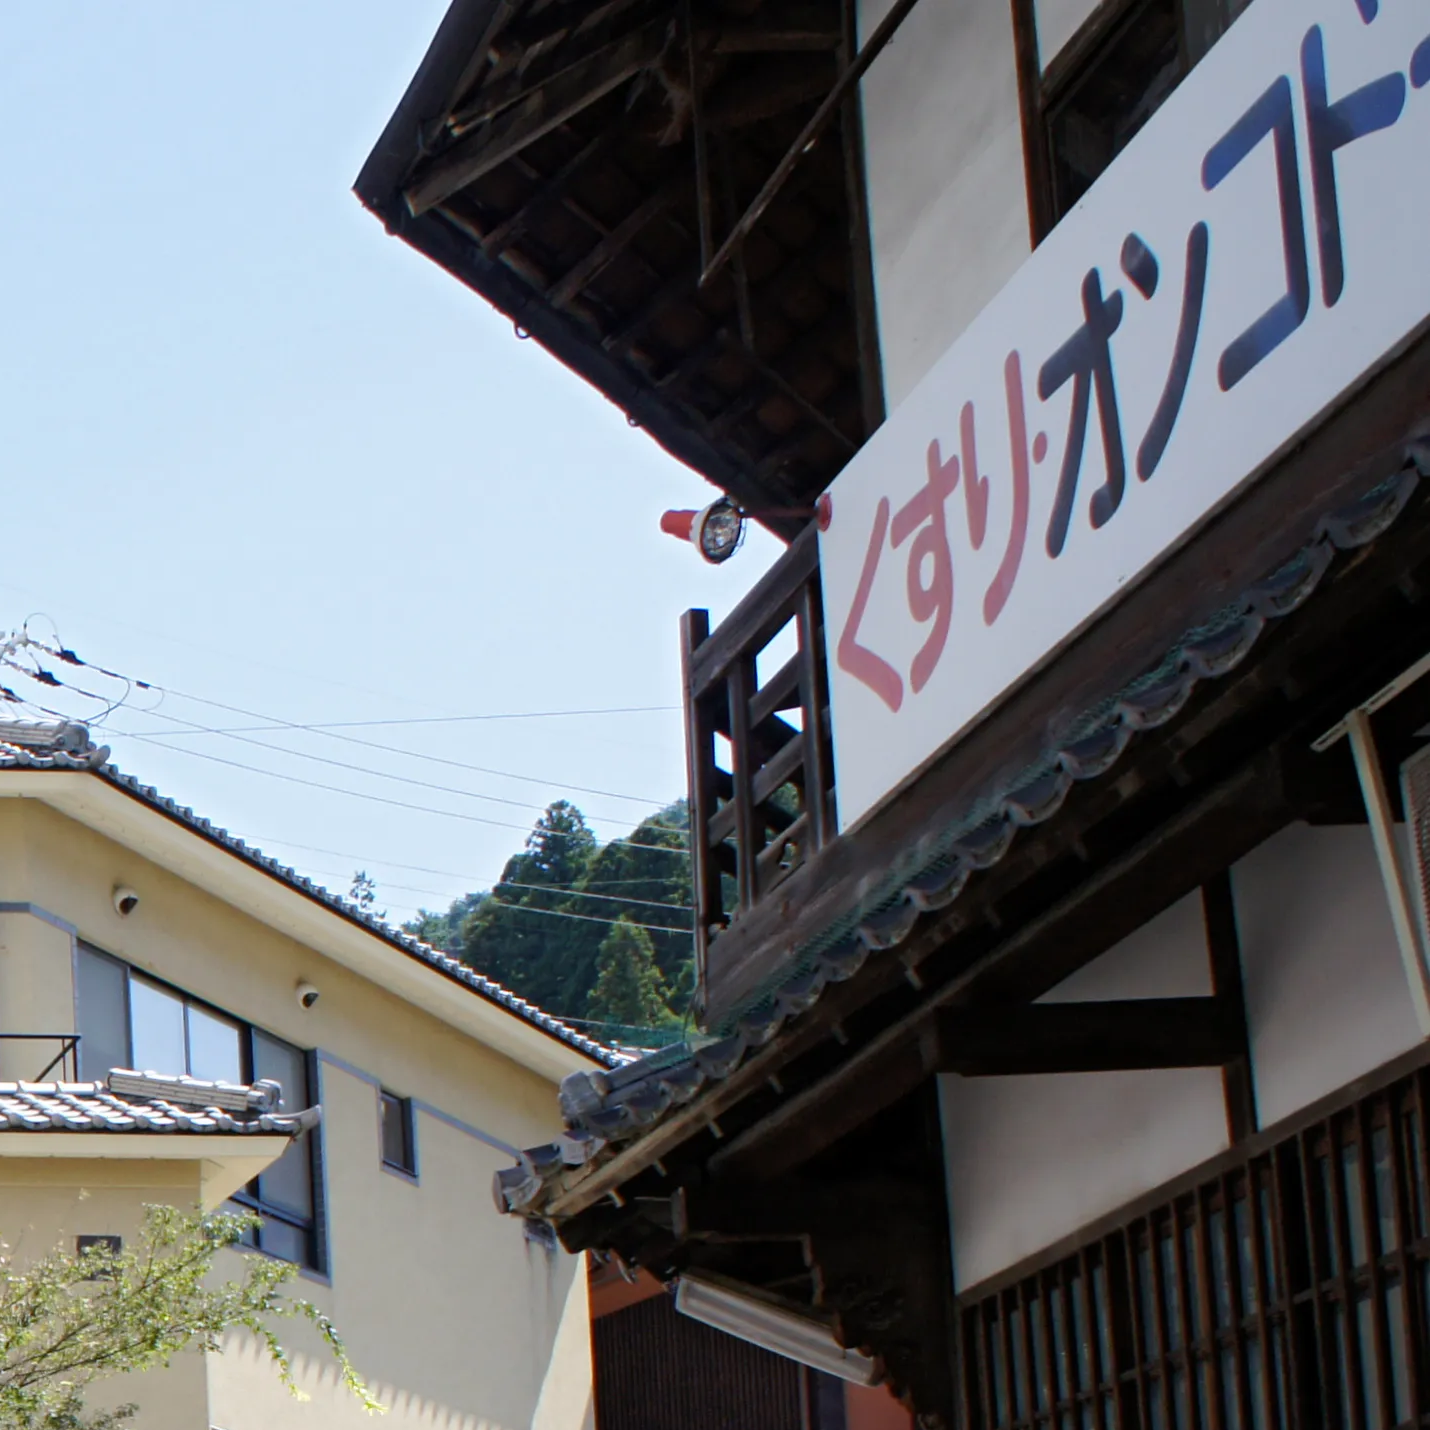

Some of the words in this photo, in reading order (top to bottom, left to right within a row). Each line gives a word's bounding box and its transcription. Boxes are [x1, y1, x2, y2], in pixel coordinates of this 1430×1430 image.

[837, 0, 1430, 713] くすり・オンコド
